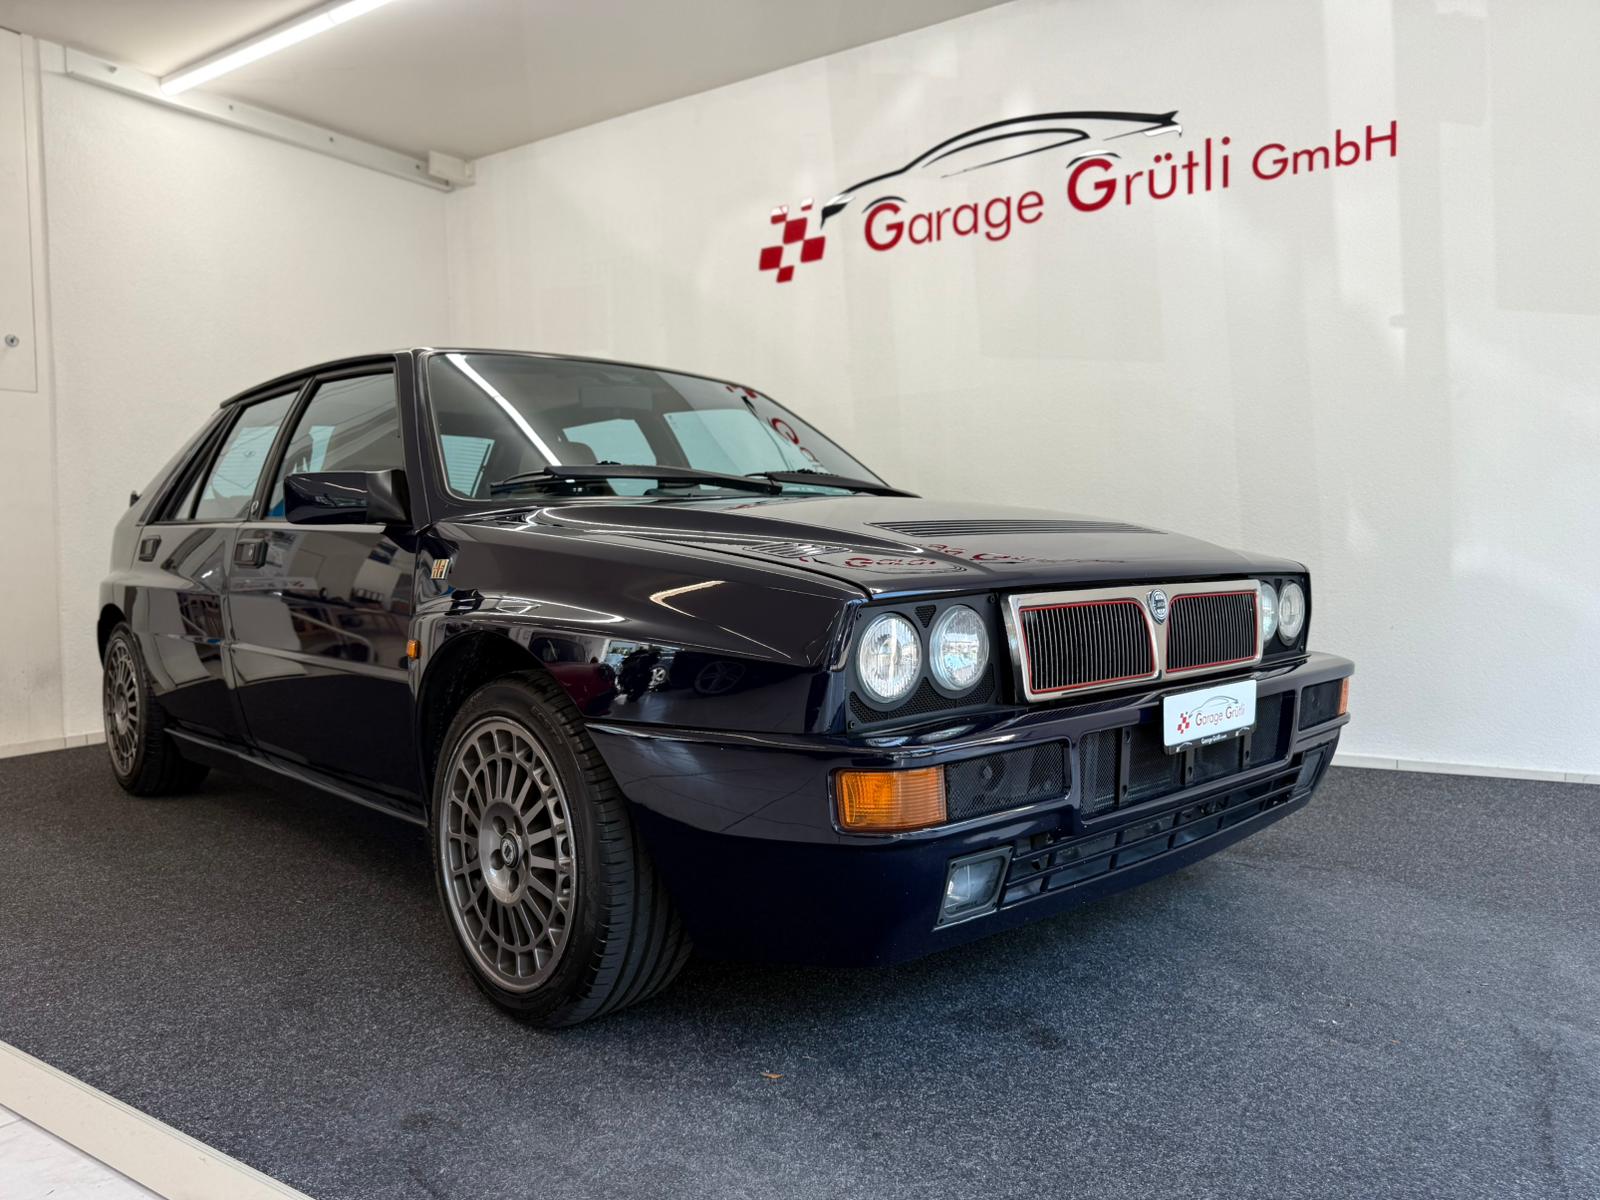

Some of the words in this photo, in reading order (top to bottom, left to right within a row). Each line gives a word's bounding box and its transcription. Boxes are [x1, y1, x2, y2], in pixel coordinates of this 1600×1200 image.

[864, 191, 1045, 252] Garage
[1067, 136, 1230, 212] Grütli
[1252, 121, 1398, 180] GmbH
[1195, 712, 1223, 727] Garage
